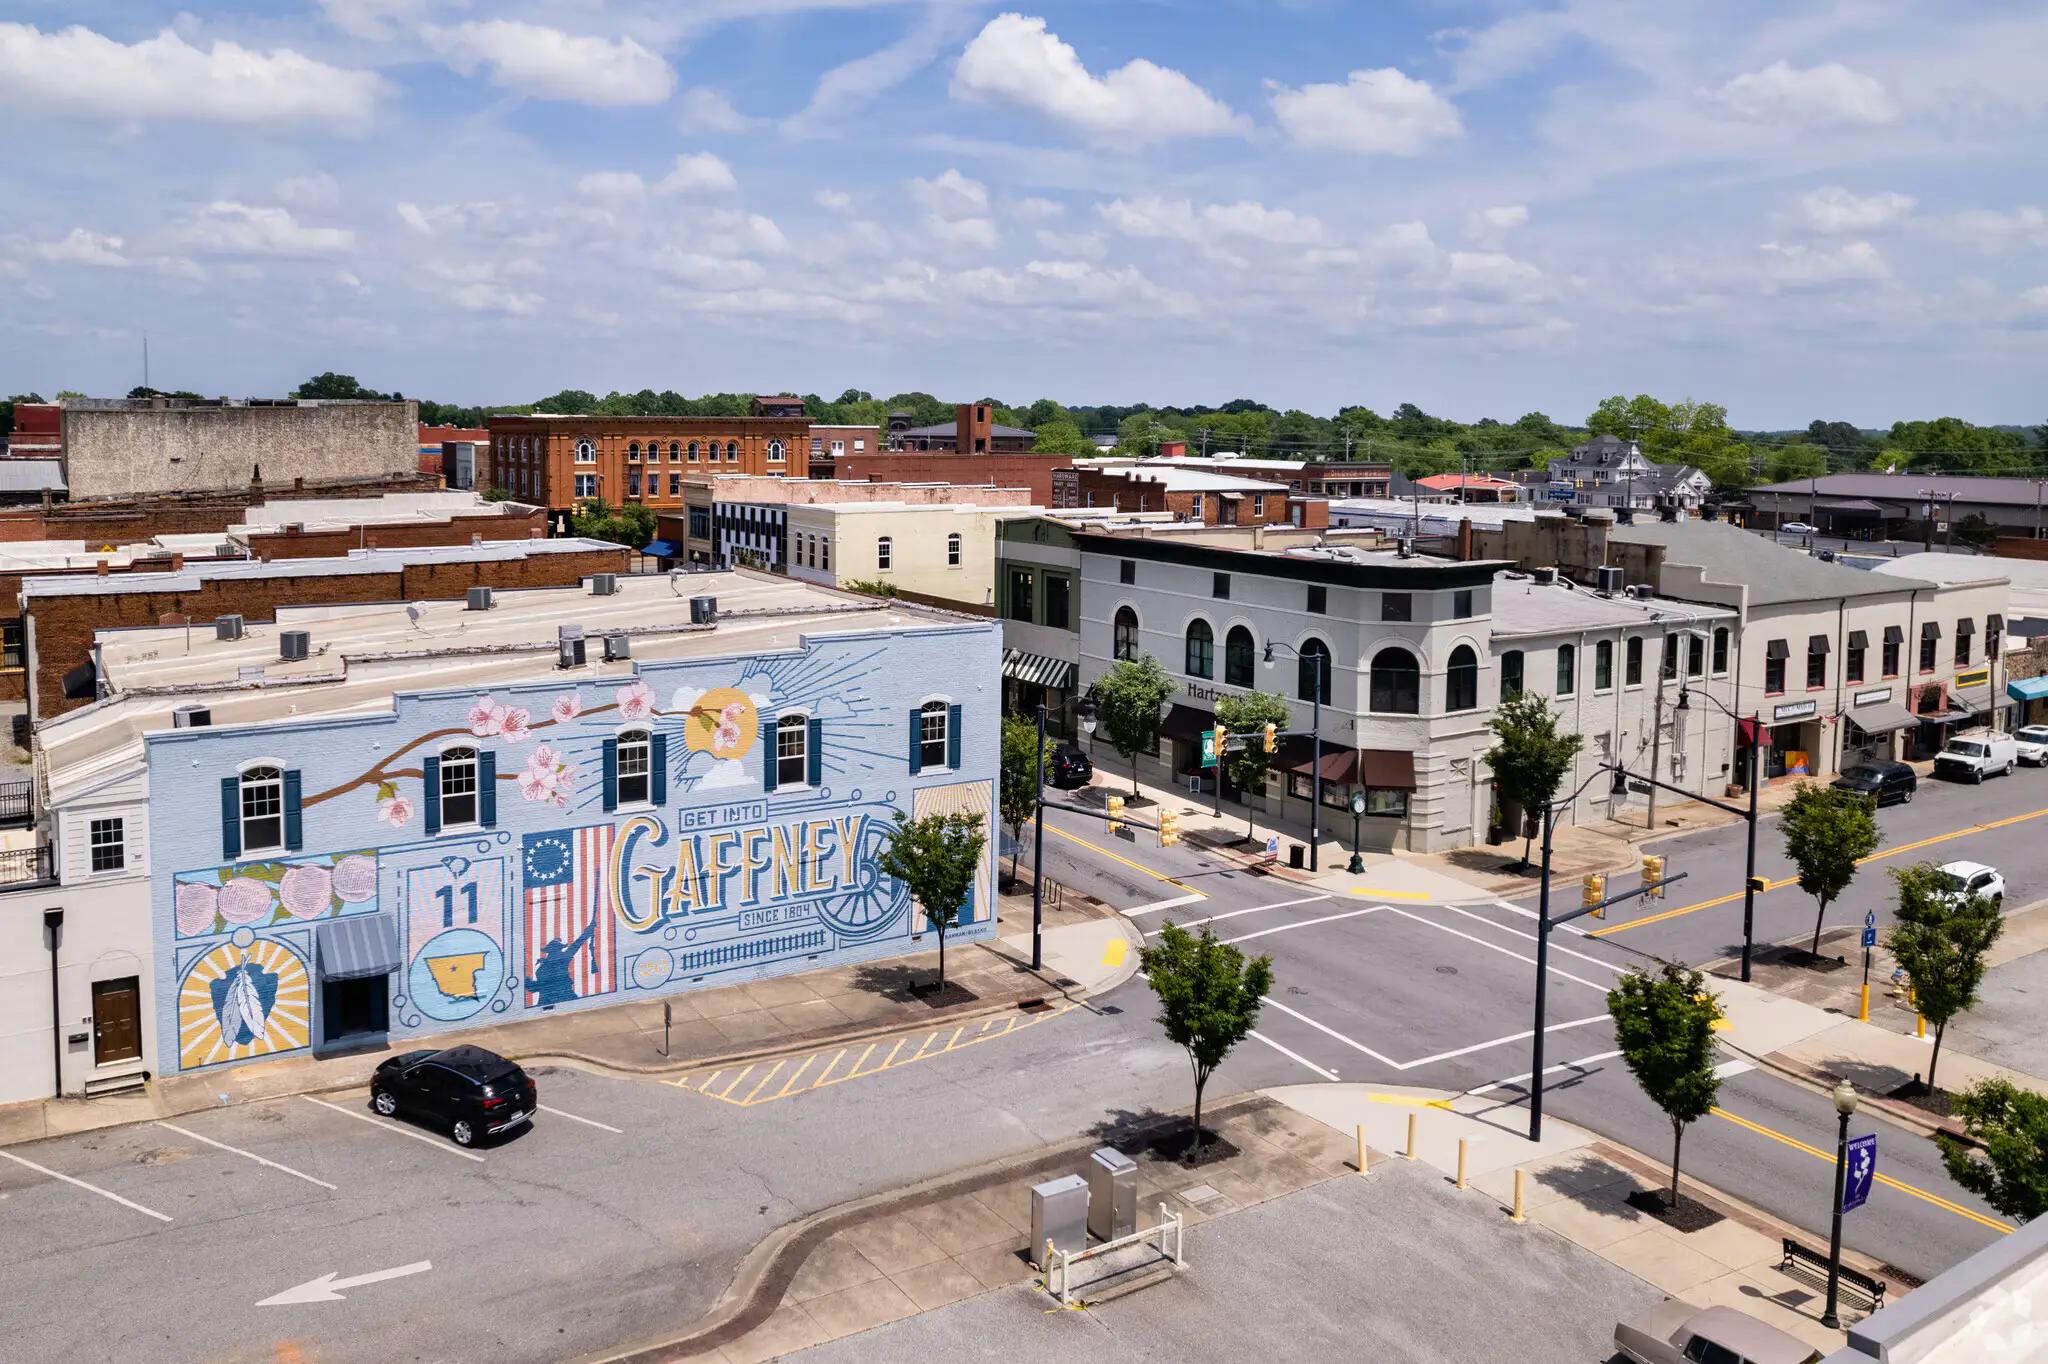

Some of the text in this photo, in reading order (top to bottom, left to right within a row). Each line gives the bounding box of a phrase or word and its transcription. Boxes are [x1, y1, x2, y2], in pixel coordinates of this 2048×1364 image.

[684, 804, 762, 827] GET INTO
[609, 813, 869, 935] GAFFNEY
[435, 881, 478, 928] 11
[744, 903, 810, 926] SINCE 1804
[1848, 1138, 1875, 1151] WELCOME
